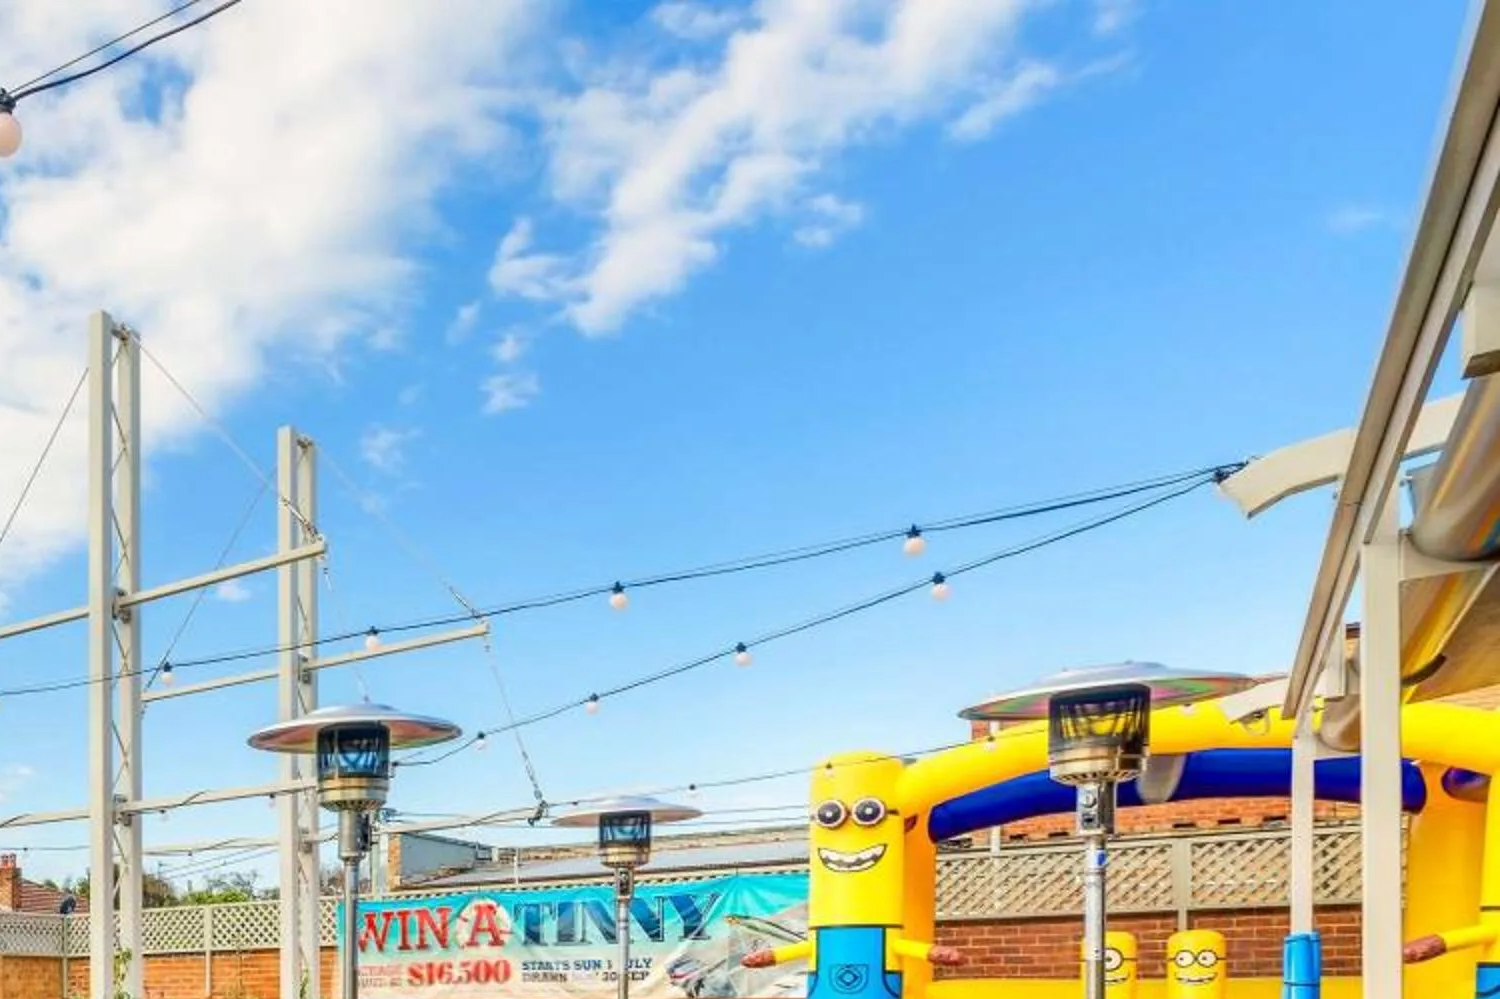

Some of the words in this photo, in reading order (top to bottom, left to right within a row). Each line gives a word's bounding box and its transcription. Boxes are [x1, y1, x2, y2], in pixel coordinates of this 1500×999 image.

[358, 907, 452, 952] WIN
[466, 903, 506, 947] A
[522, 959, 570, 971] STARTS
[573, 959, 602, 970] SUN
[624, 957, 653, 969] ULY
